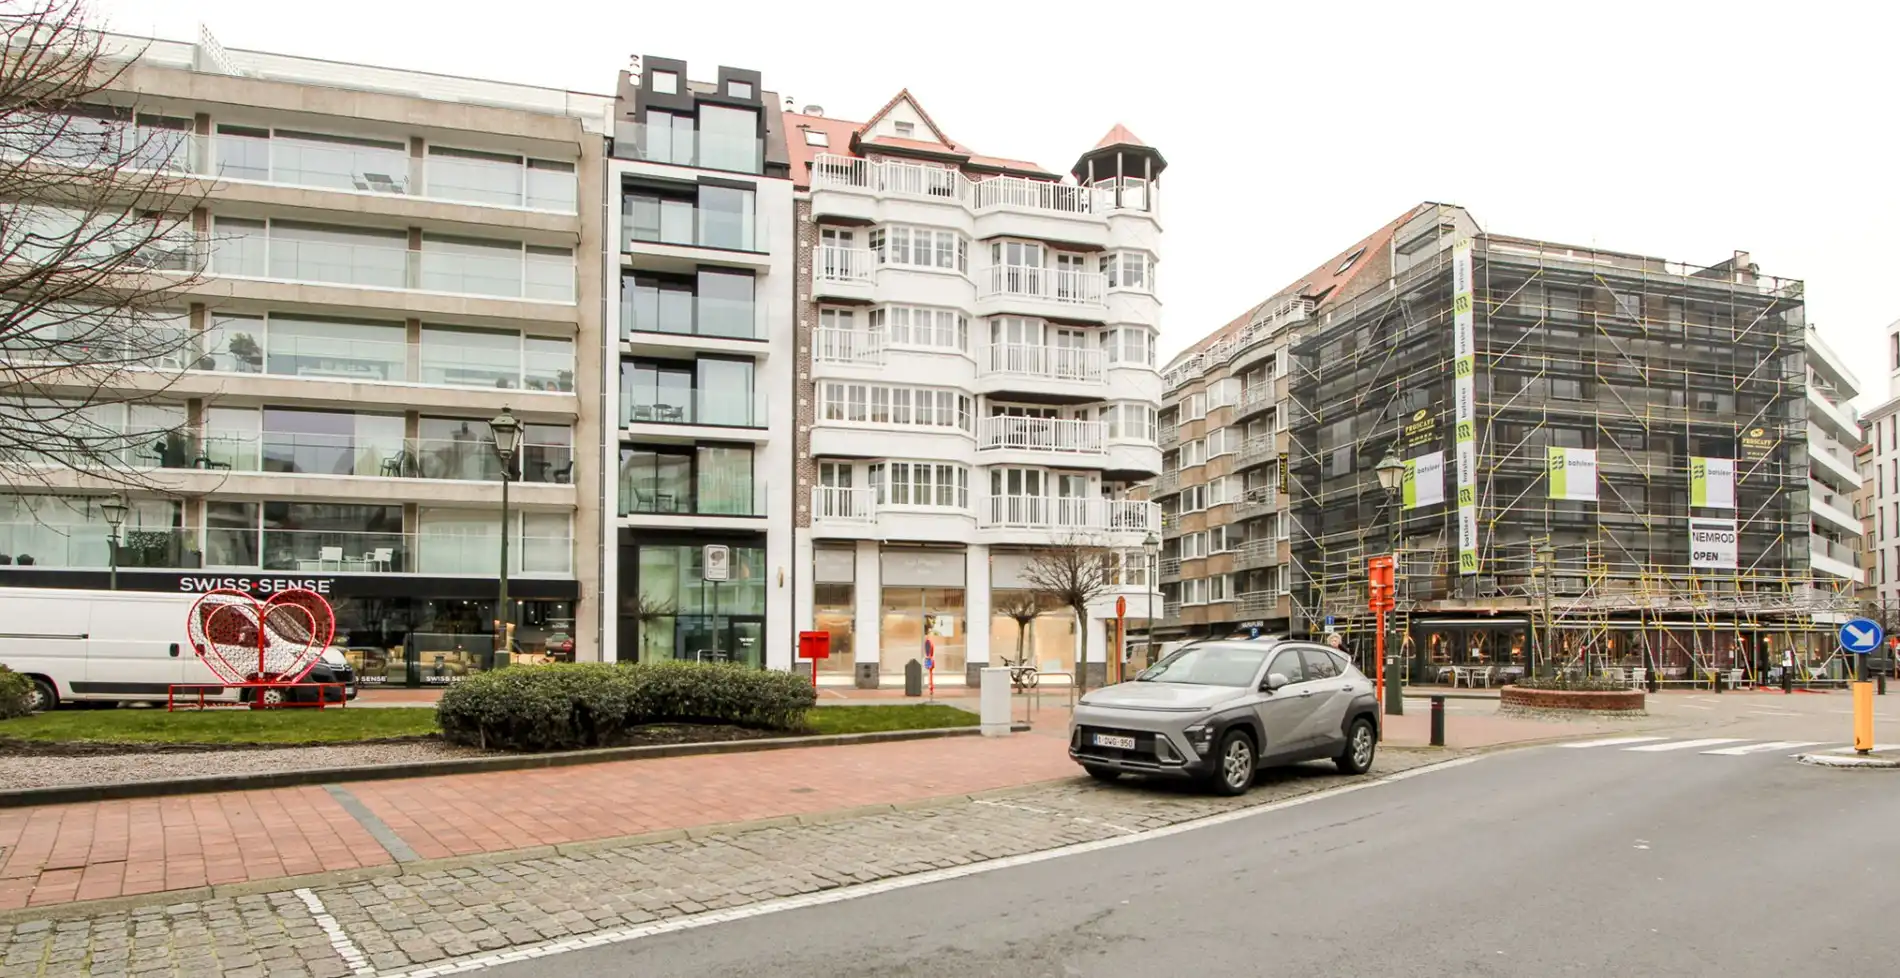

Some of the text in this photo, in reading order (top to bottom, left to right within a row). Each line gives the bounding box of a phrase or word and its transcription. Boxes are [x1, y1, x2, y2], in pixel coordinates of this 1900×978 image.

[1692, 532, 1735, 544] NEMROD
[1693, 551, 1719, 561] OPEN
[179, 577, 331, 593] SWISS SENSE
